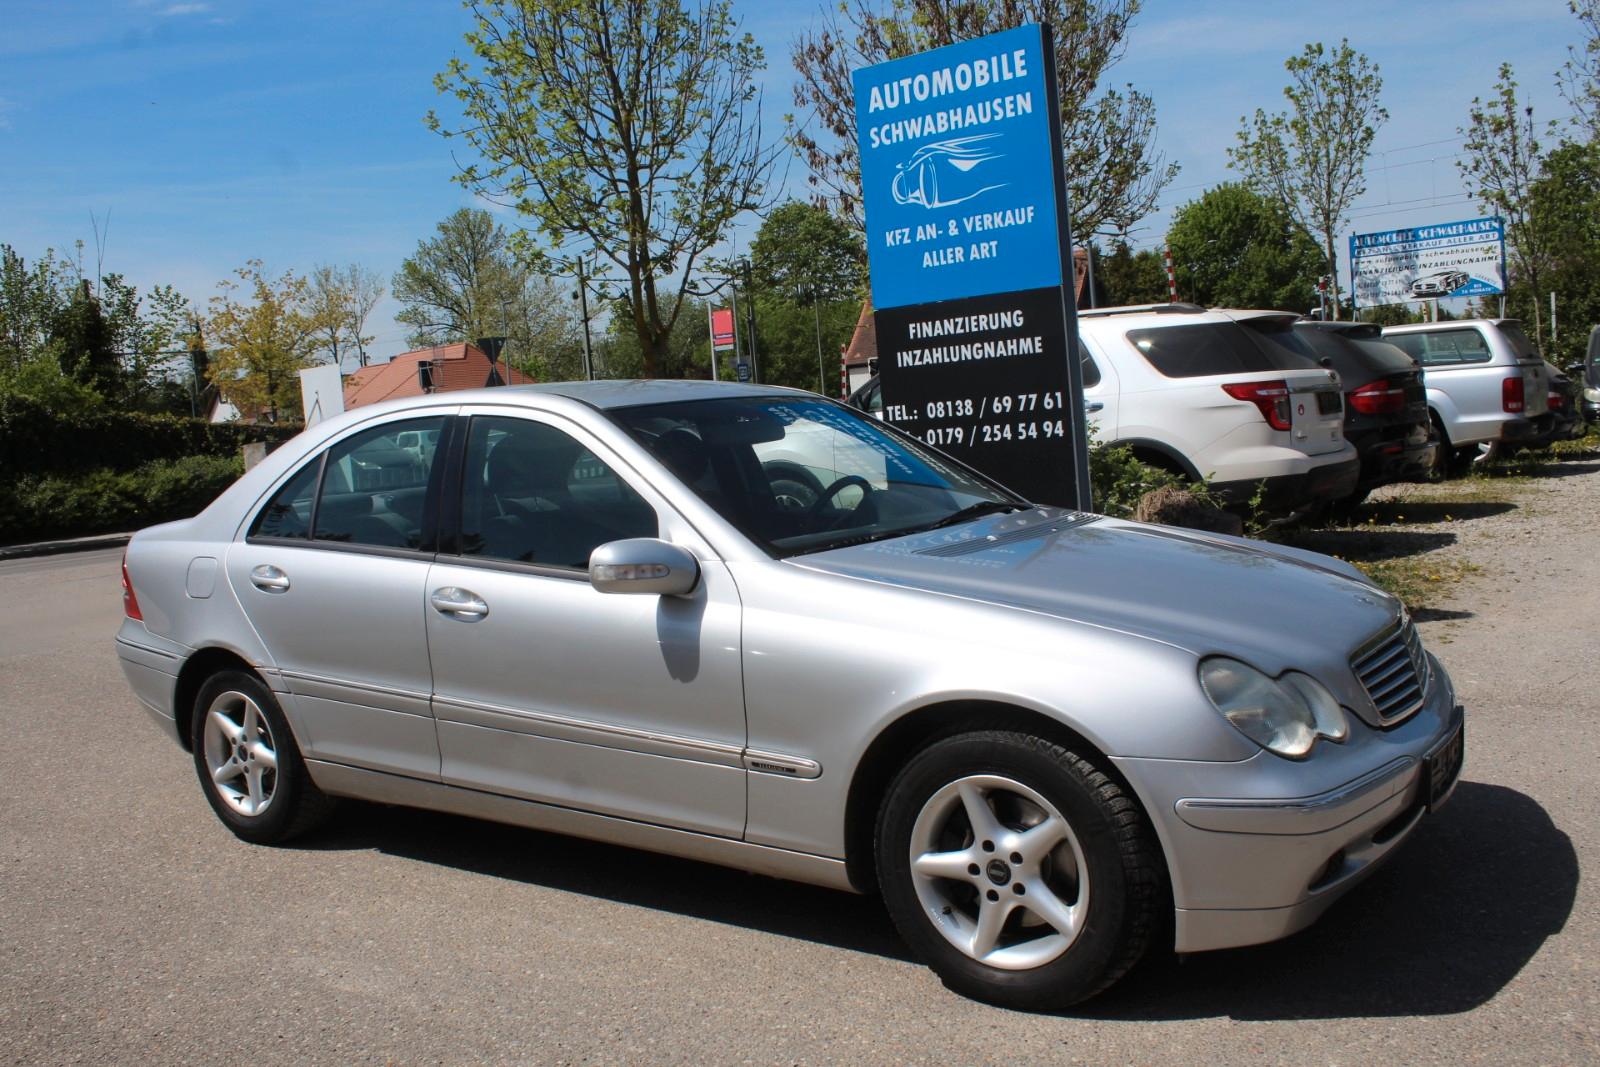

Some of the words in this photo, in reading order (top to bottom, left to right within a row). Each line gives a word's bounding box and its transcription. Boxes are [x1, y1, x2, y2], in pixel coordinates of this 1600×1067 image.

[868, 49, 1027, 113] AUTOMOBILE
[869, 91, 1032, 149] SCHWABHAUSEN
[885, 227, 911, 247] KFZ
[916, 222, 943, 242] AN-
[948, 219, 959, 236] &
[963, 205, 1035, 233] VERKAUF
[1418, 220, 1499, 240] SCHWABHAUSEN
[1447, 235, 1474, 245] ALLER
[1478, 232, 1497, 241] ART
[922, 247, 965, 268] ALLER
[969, 241, 998, 261] ART
[909, 309, 1024, 339] FINANZIERUNG
[896, 336, 1043, 368] INZAHLUNGNAHME
[886, 404, 918, 421] TEL.:
[926, 399, 973, 419] 08138
[979, 397, 987, 419] /
[992, 395, 1012, 414] 69
[1018, 393, 1038, 411] 77
[1043, 391, 1062, 410] 61
[926, 427, 964, 445] 0179
[969, 425, 977, 447] /
[982, 424, 1012, 442] 254
[1018, 422, 1038, 440] 54
[1043, 420, 1064, 438] 94
